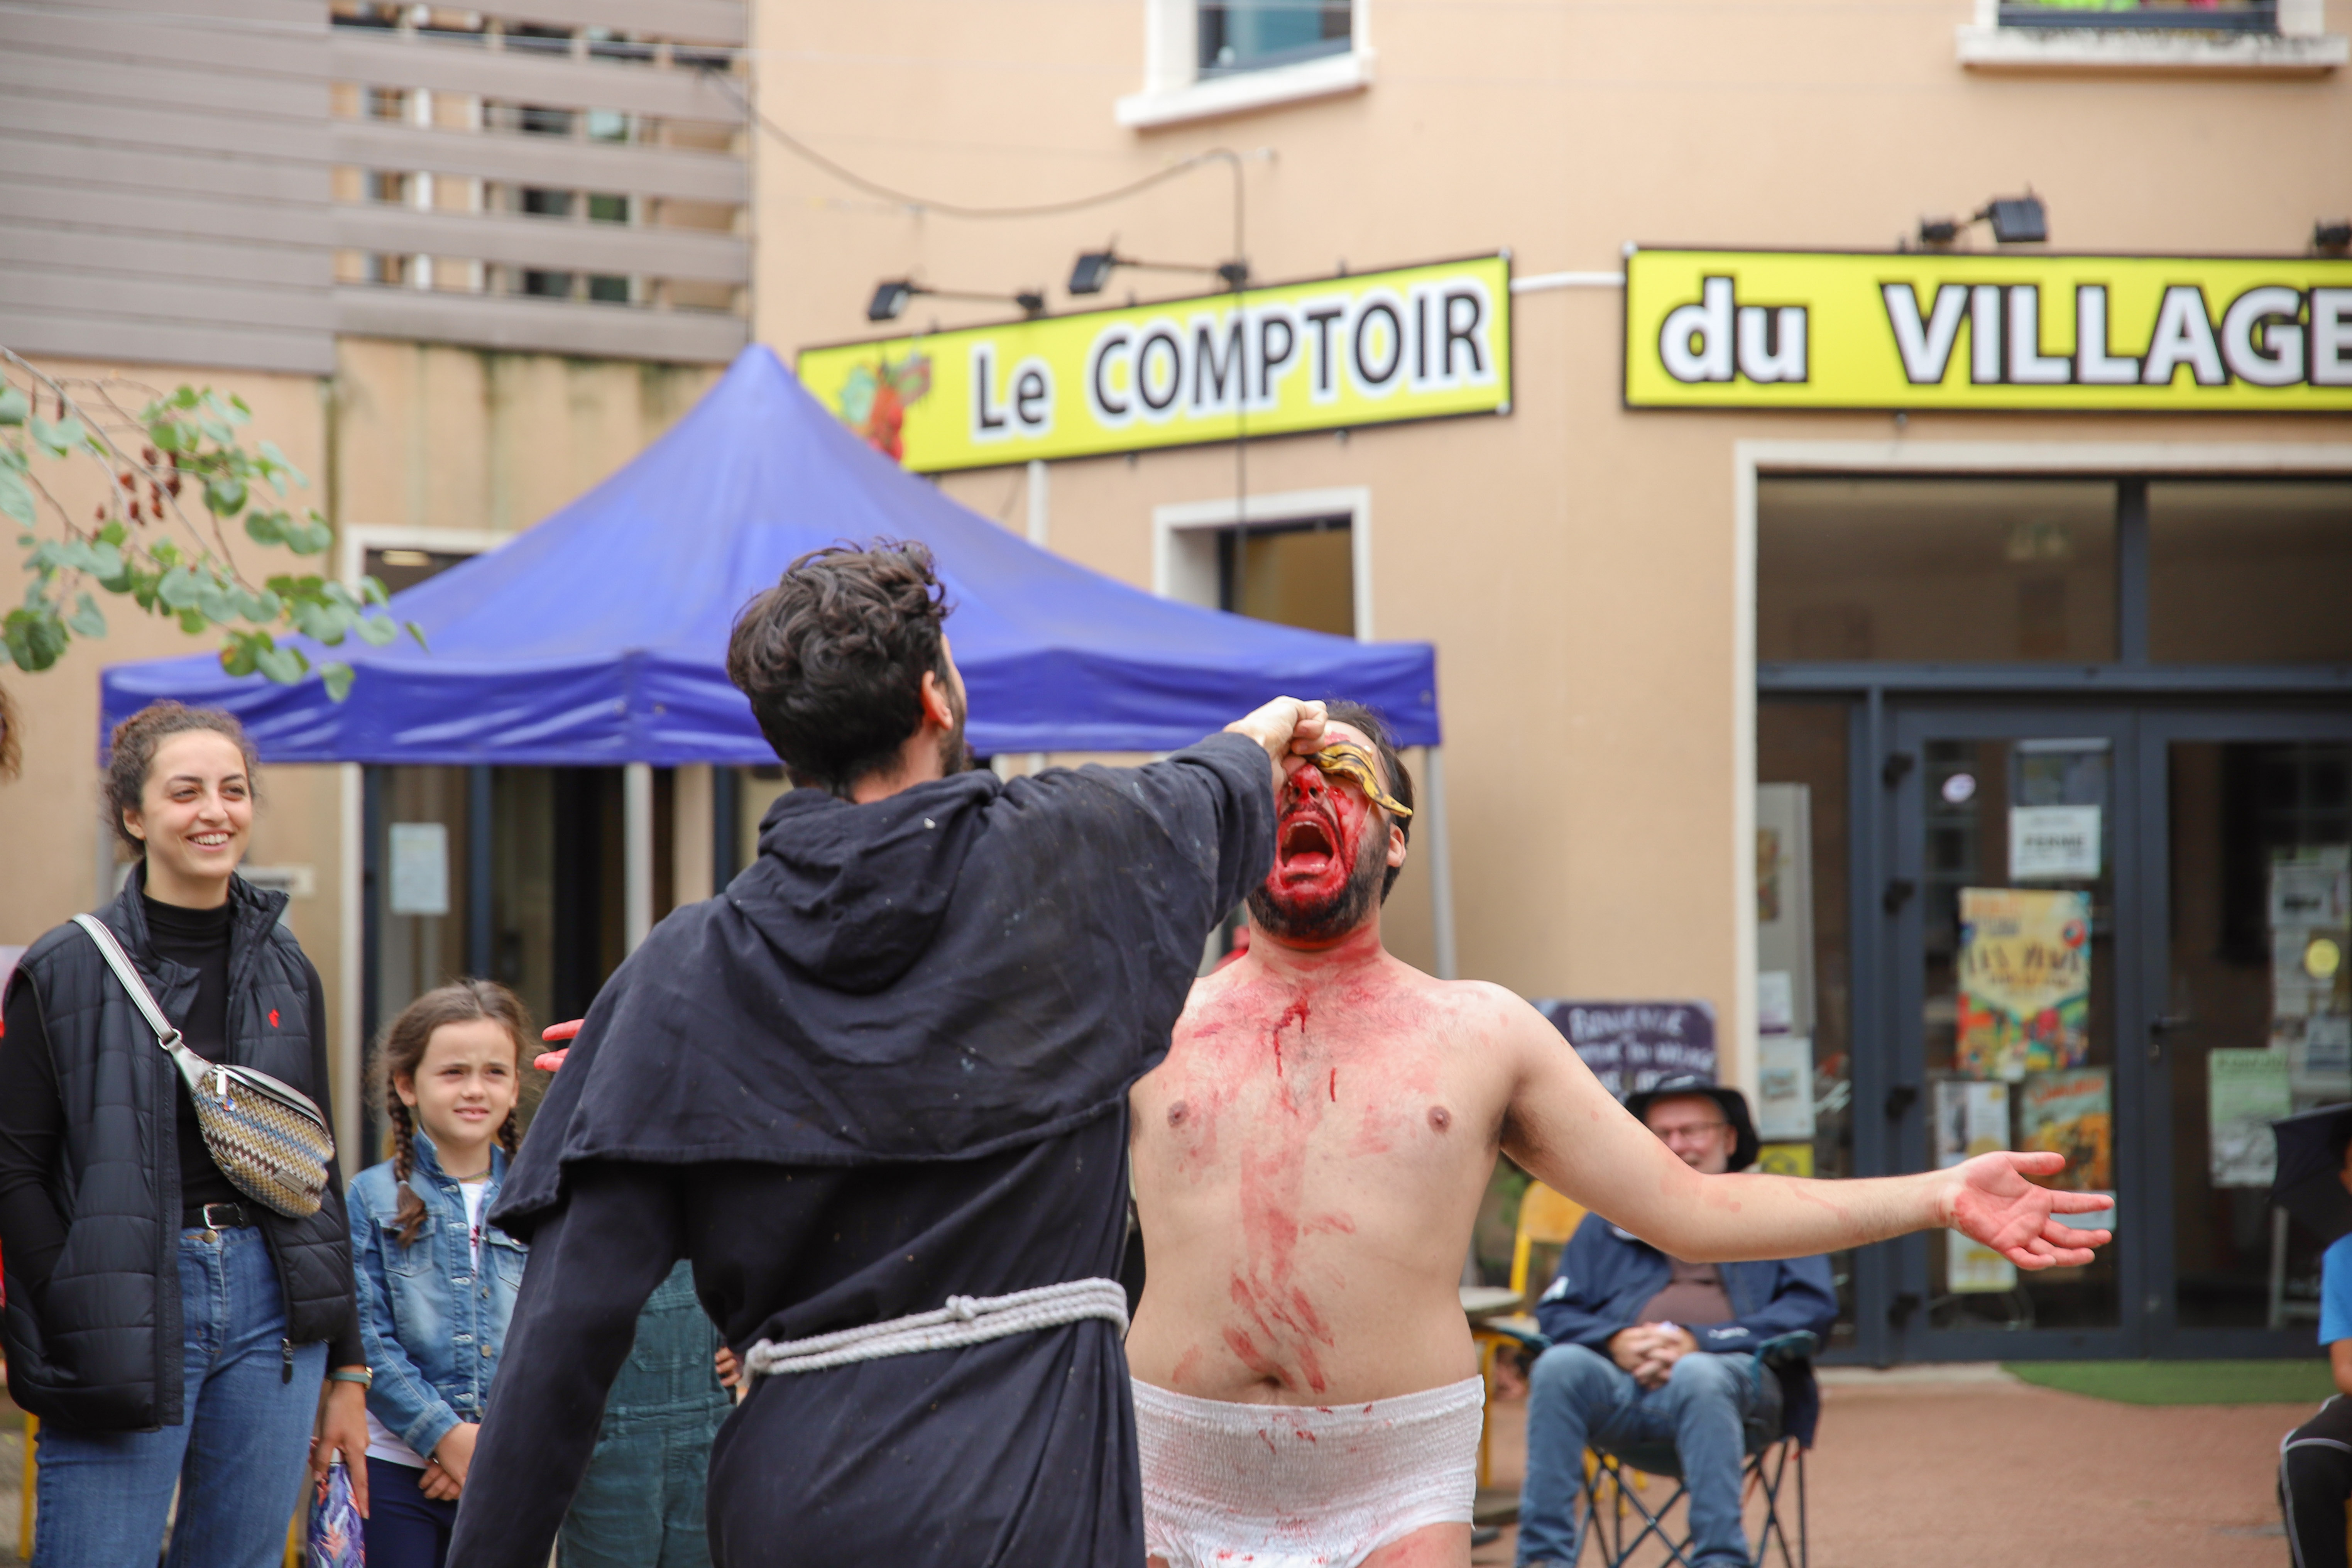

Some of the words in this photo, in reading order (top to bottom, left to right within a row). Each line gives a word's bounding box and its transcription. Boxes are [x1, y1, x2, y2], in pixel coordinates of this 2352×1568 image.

[980, 354, 1045, 428] Le
[1095, 292, 1482, 414] COMPTOIR
[1659, 276, 1808, 384] du
[1879, 282, 2352, 386] VILLAGE
